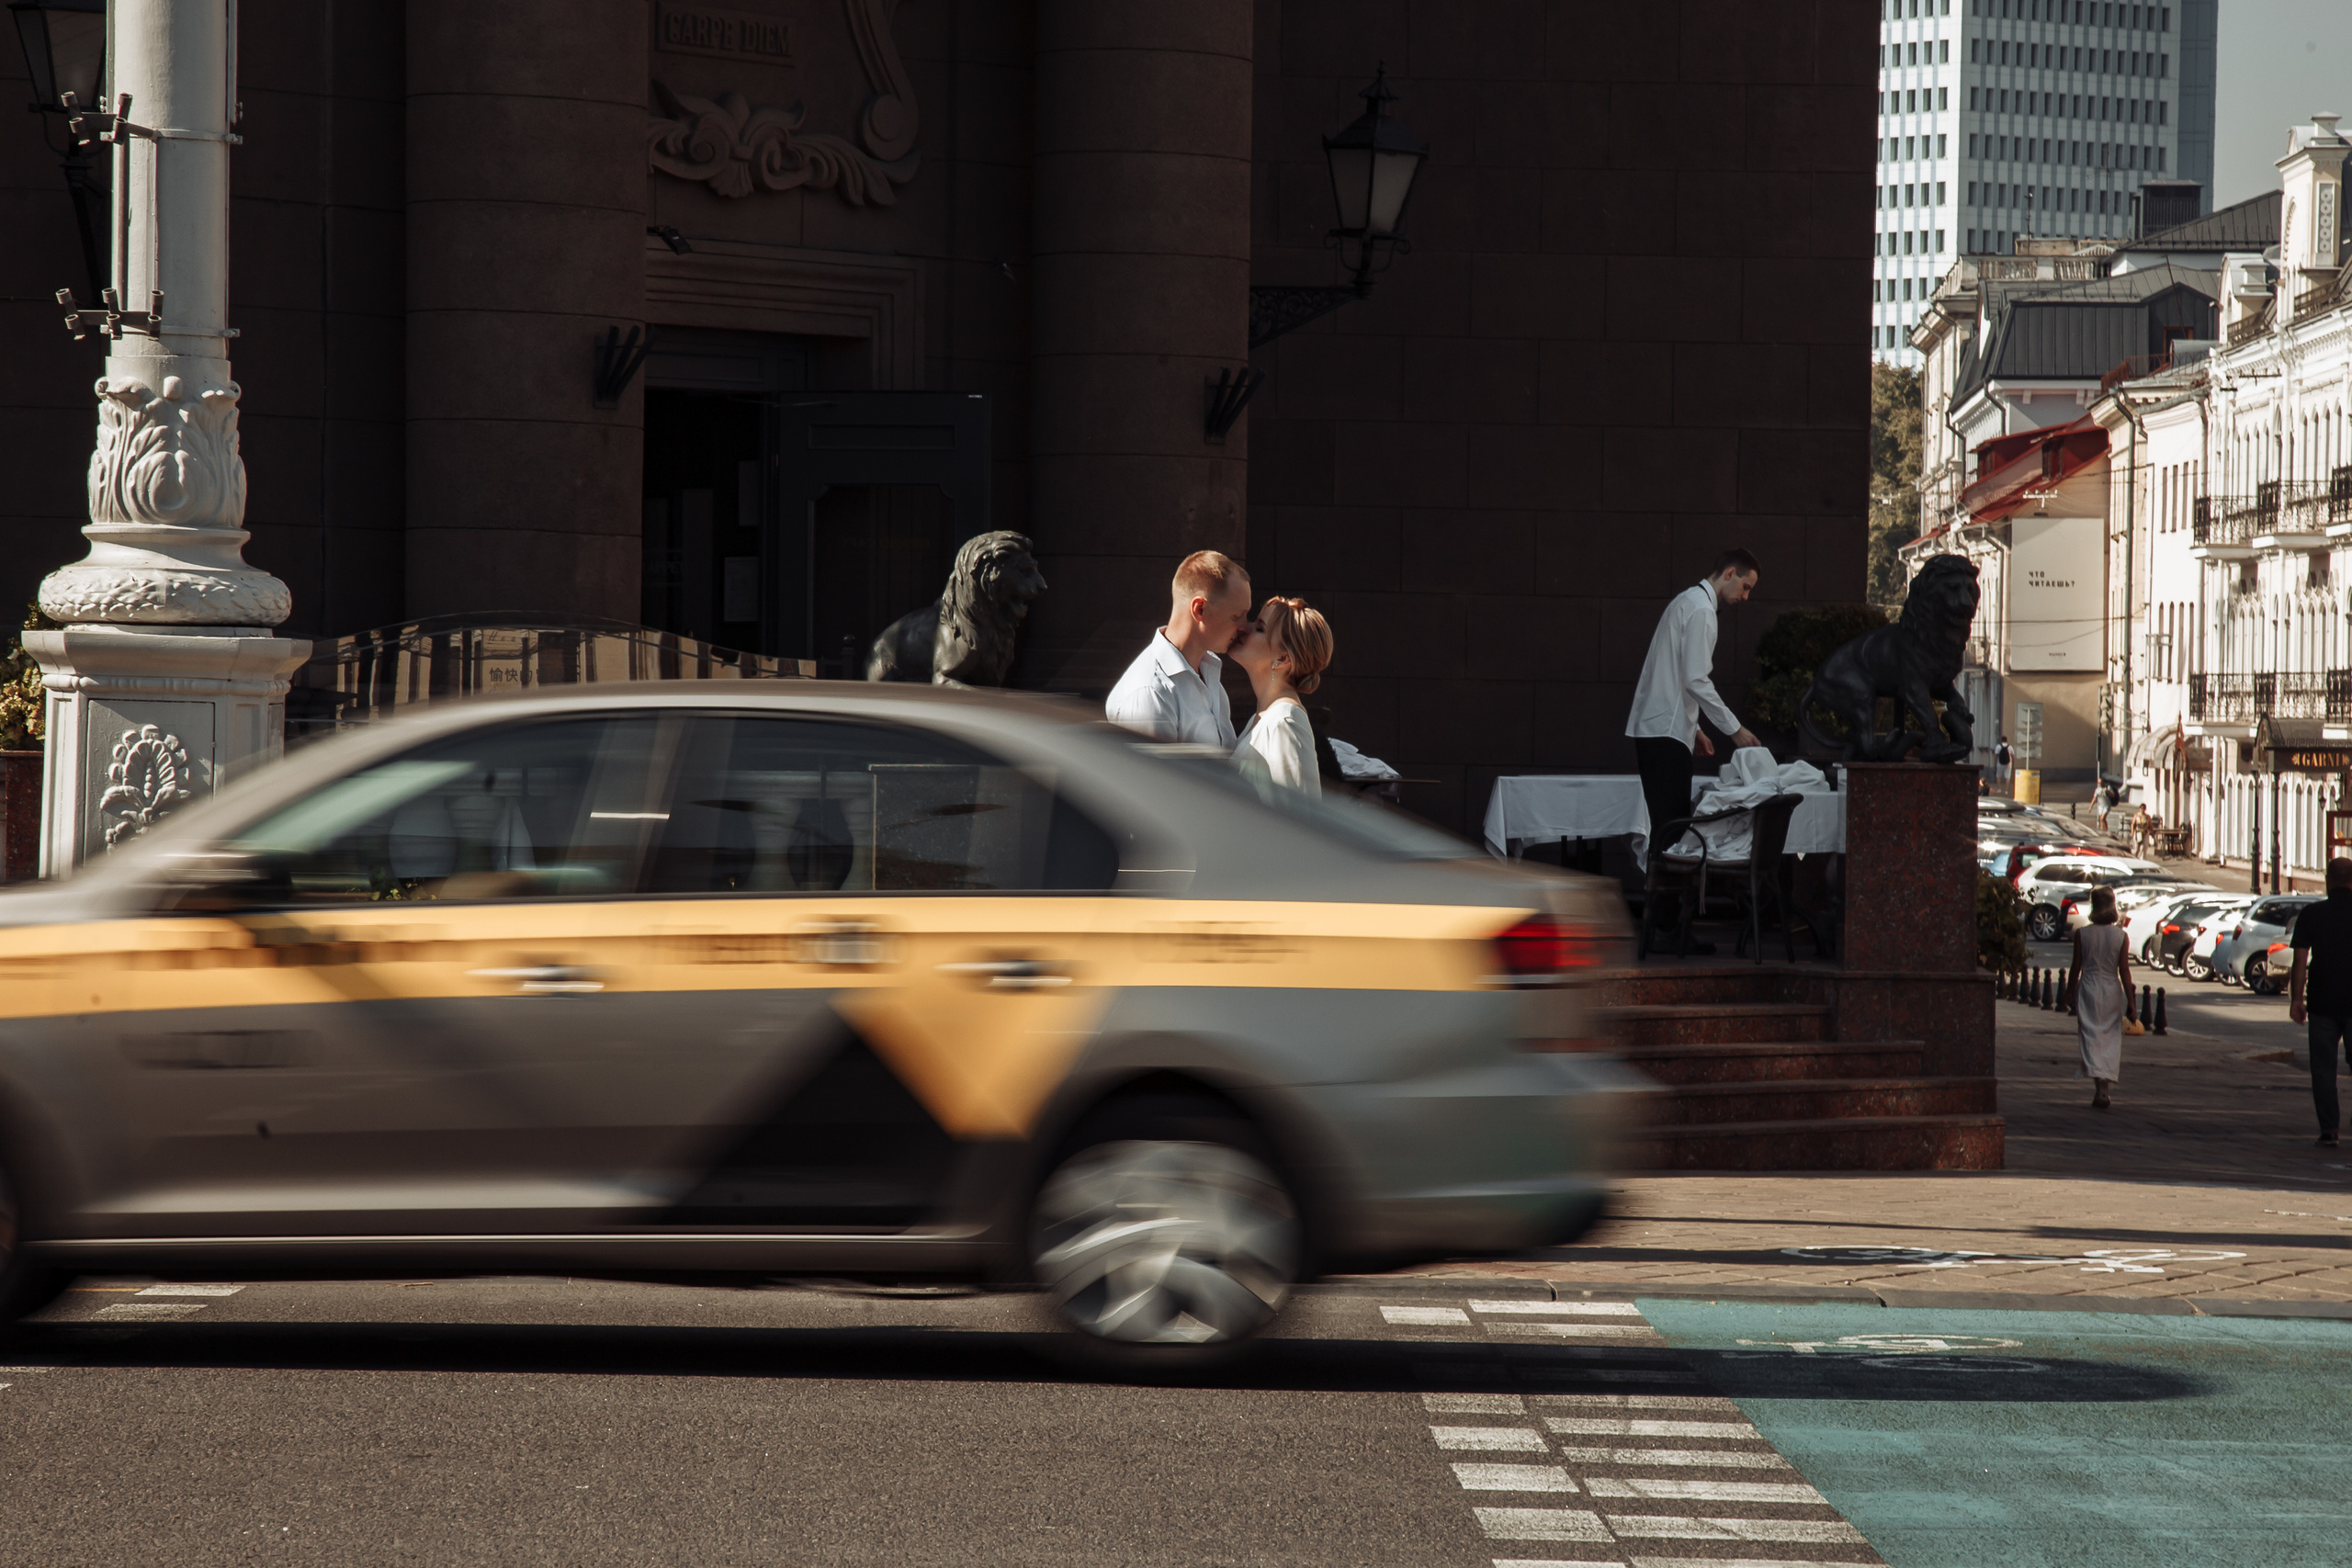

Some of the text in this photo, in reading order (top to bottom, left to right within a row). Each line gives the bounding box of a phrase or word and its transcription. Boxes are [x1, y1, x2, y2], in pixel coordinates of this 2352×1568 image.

[665, 12, 793, 58] CARPE DIEM
[2029, 580, 2075, 588] ЧИТАЕШЬ?
[2301, 752, 2339, 767] GARNI
